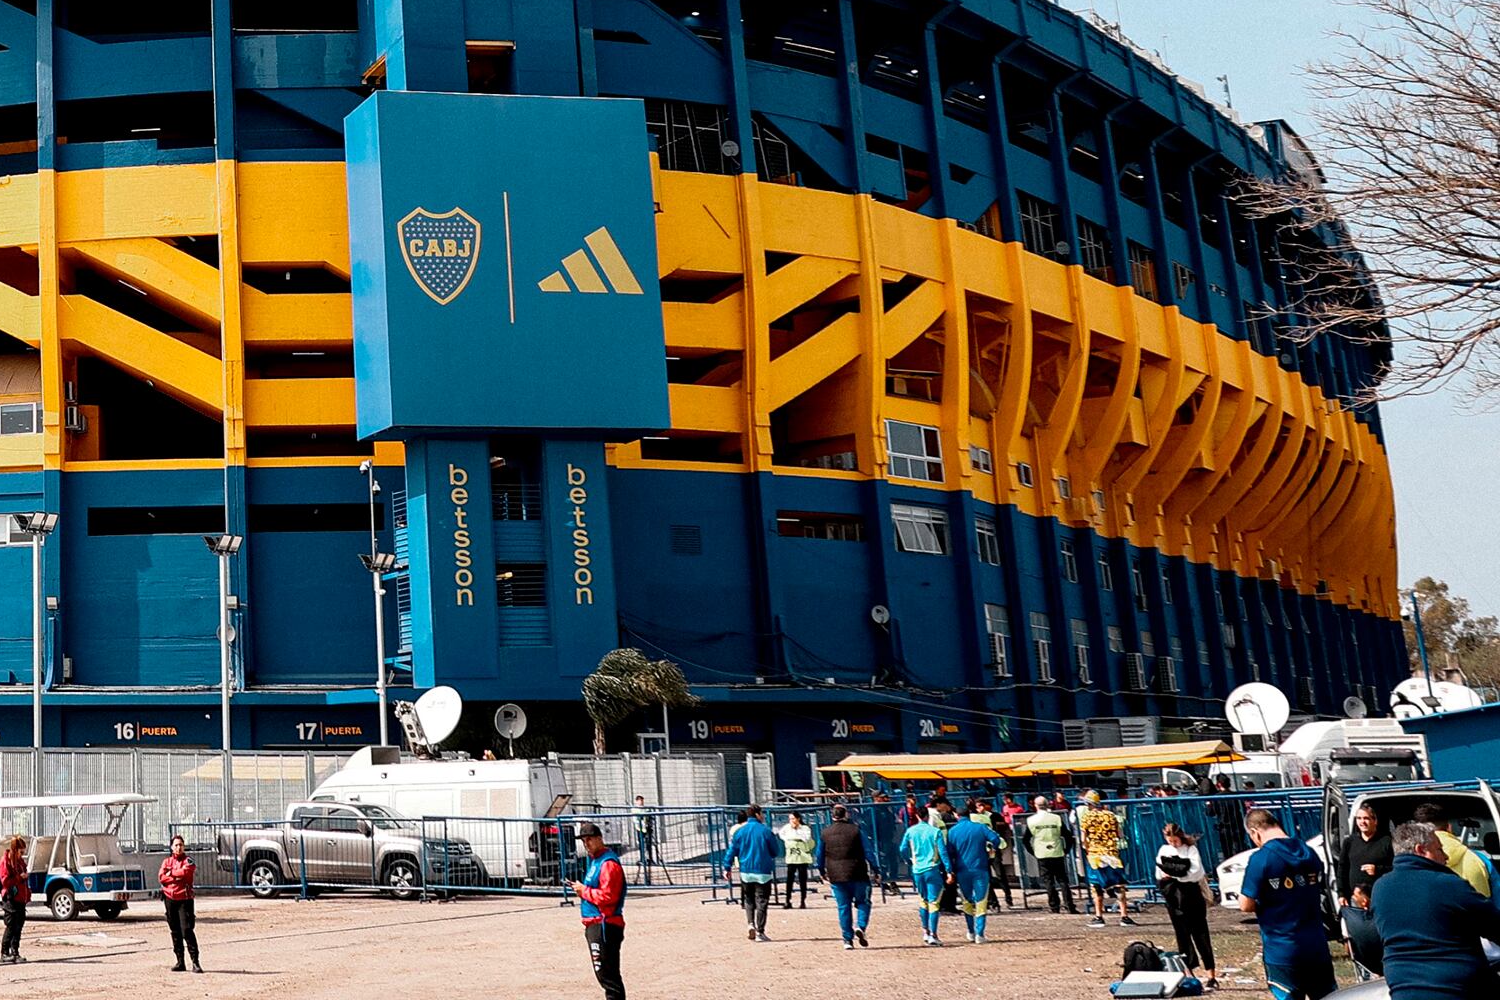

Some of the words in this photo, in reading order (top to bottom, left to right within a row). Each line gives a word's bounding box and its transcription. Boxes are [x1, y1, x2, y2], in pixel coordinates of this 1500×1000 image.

[409, 238, 471, 257] CABJ
[449, 463, 474, 606] betsson
[567, 463, 594, 605] betsson
[113, 722, 134, 740] 16
[141, 727, 177, 735] PUERTA
[295, 722, 318, 740] 17
[324, 726, 363, 735] PUERTA
[688, 720, 709, 739] 19
[831, 719, 848, 738] 20
[919, 719, 934, 737] 20
